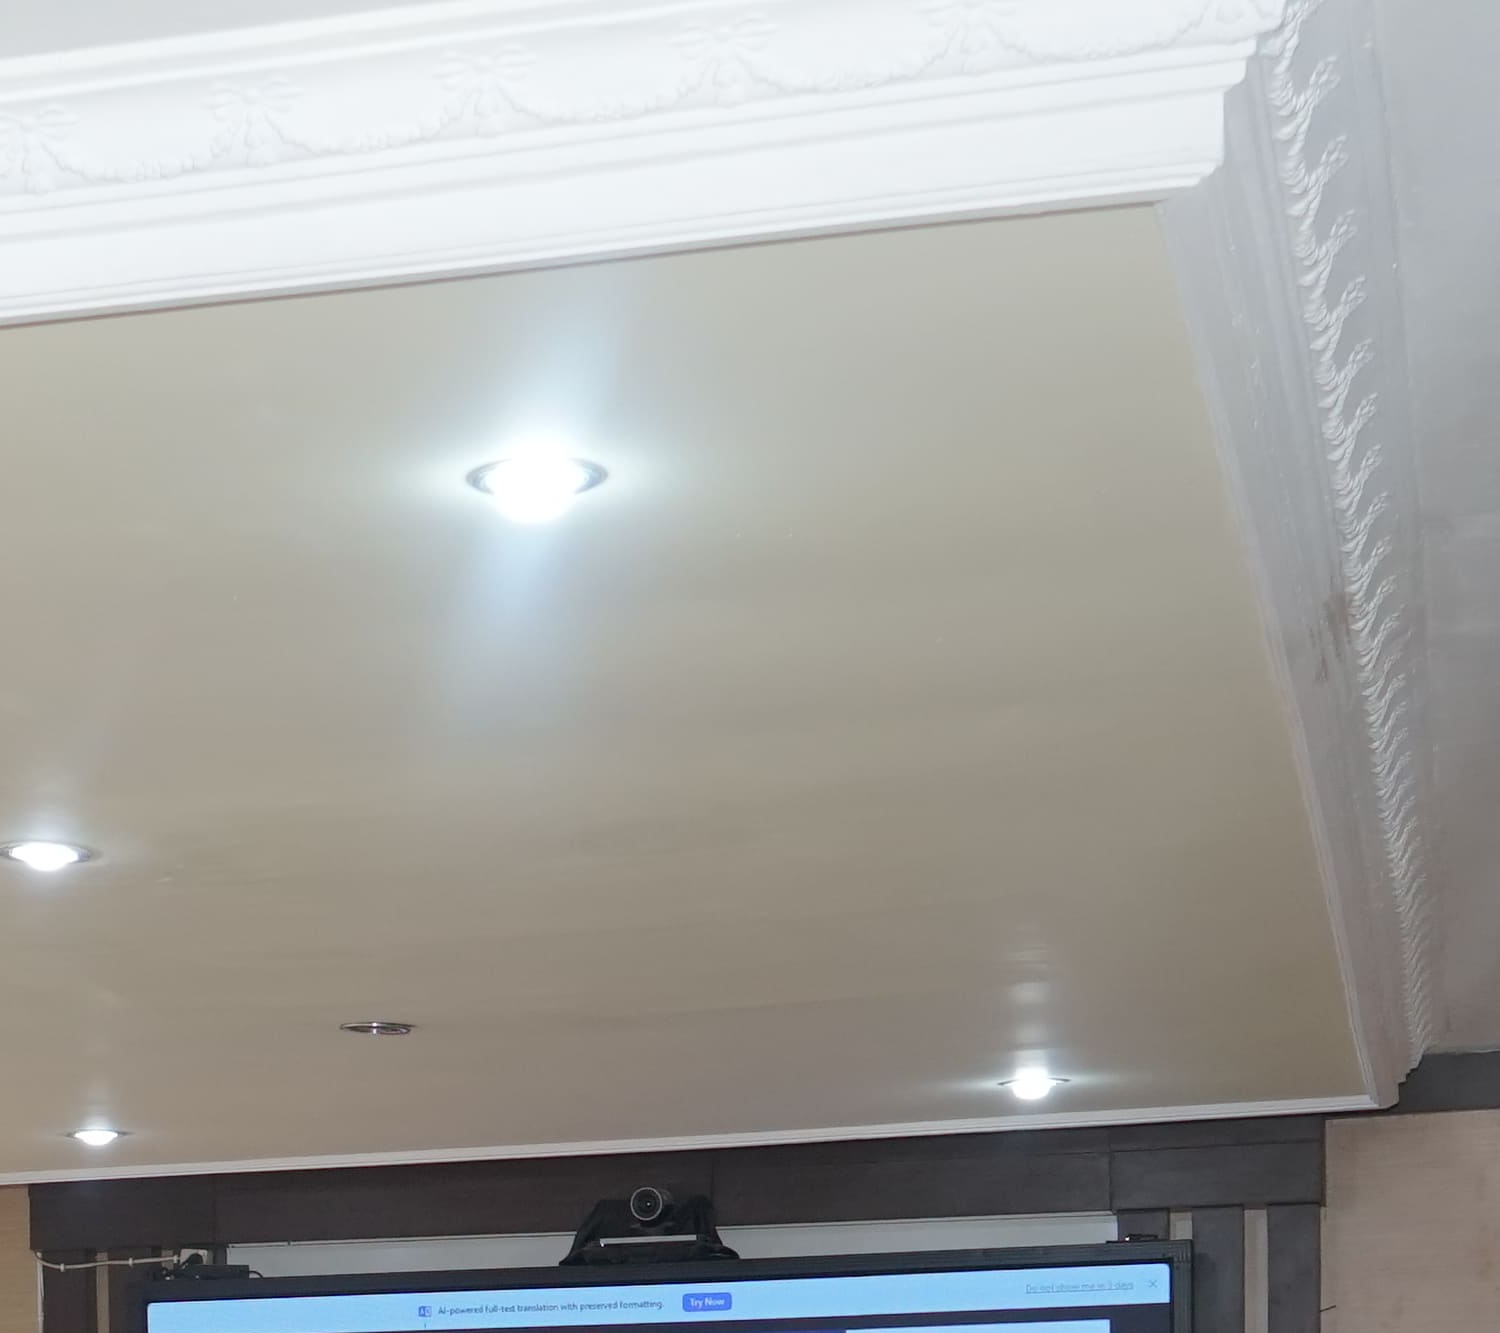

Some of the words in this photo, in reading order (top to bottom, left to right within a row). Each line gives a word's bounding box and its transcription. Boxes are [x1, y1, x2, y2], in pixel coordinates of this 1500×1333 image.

[517, 1302, 559, 1312] translation
[561, 1302, 578, 1311] with
[580, 1302, 618, 1312] preserved
[689, 1298, 702, 1309] Try
[705, 1297, 725, 1307] Now
